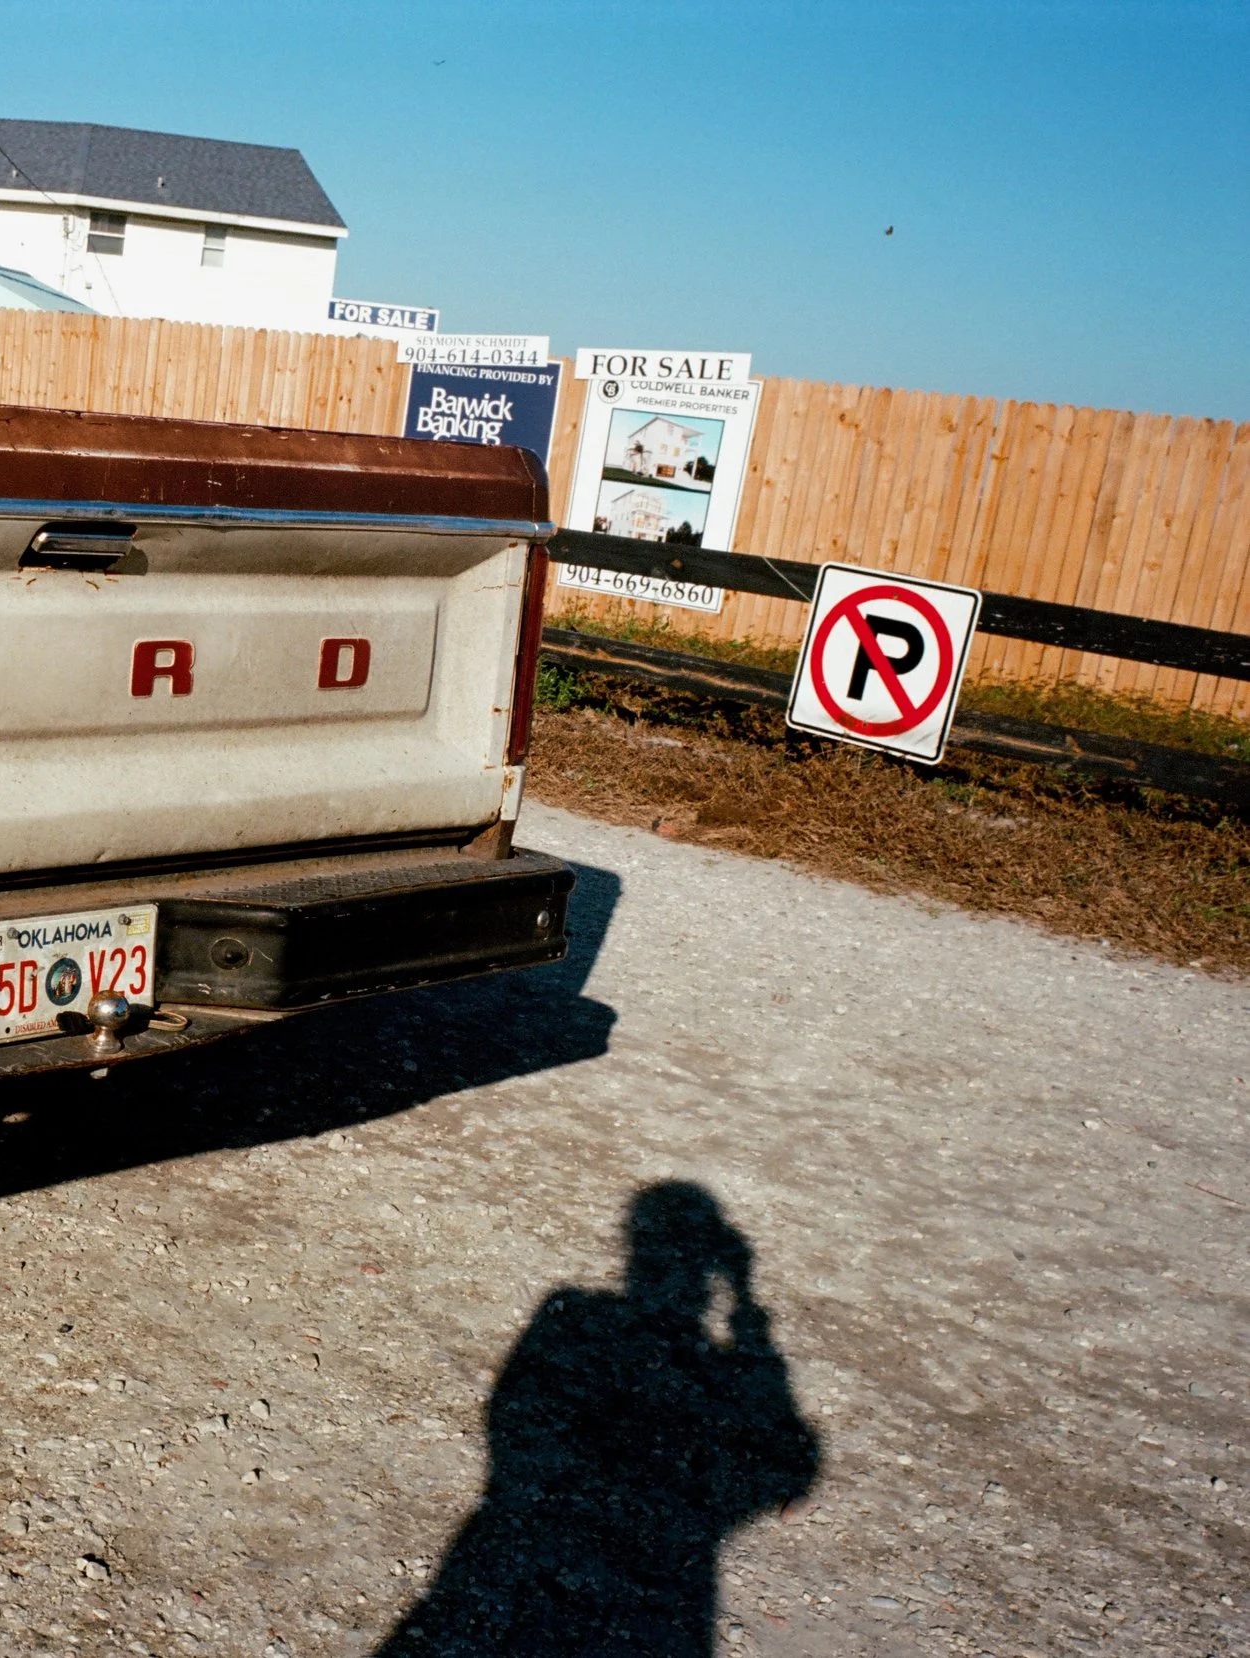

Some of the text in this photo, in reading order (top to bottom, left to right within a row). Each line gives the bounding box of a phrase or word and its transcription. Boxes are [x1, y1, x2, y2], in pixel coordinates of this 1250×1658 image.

[333, 303, 428, 330] FOR SALE
[475, 336, 527, 348] SCHMIDT
[405, 347, 538, 365] 904-614-0344
[590, 354, 734, 381] FOR SALE
[417, 363, 554, 386] FINANCING PROVIDED BY
[431, 387, 513, 421] Barwick
[631, 381, 750, 401] COLDWELL BANKER
[637, 396, 738, 415] PREMIER PROPERTIES
[416, 407, 503, 440] Banking
[566, 564, 714, 605] 904-669-6860
[847, 614, 925, 701] P
[18, 921, 112, 948] OKLAHOMA
[89, 945, 146, 997] V23
